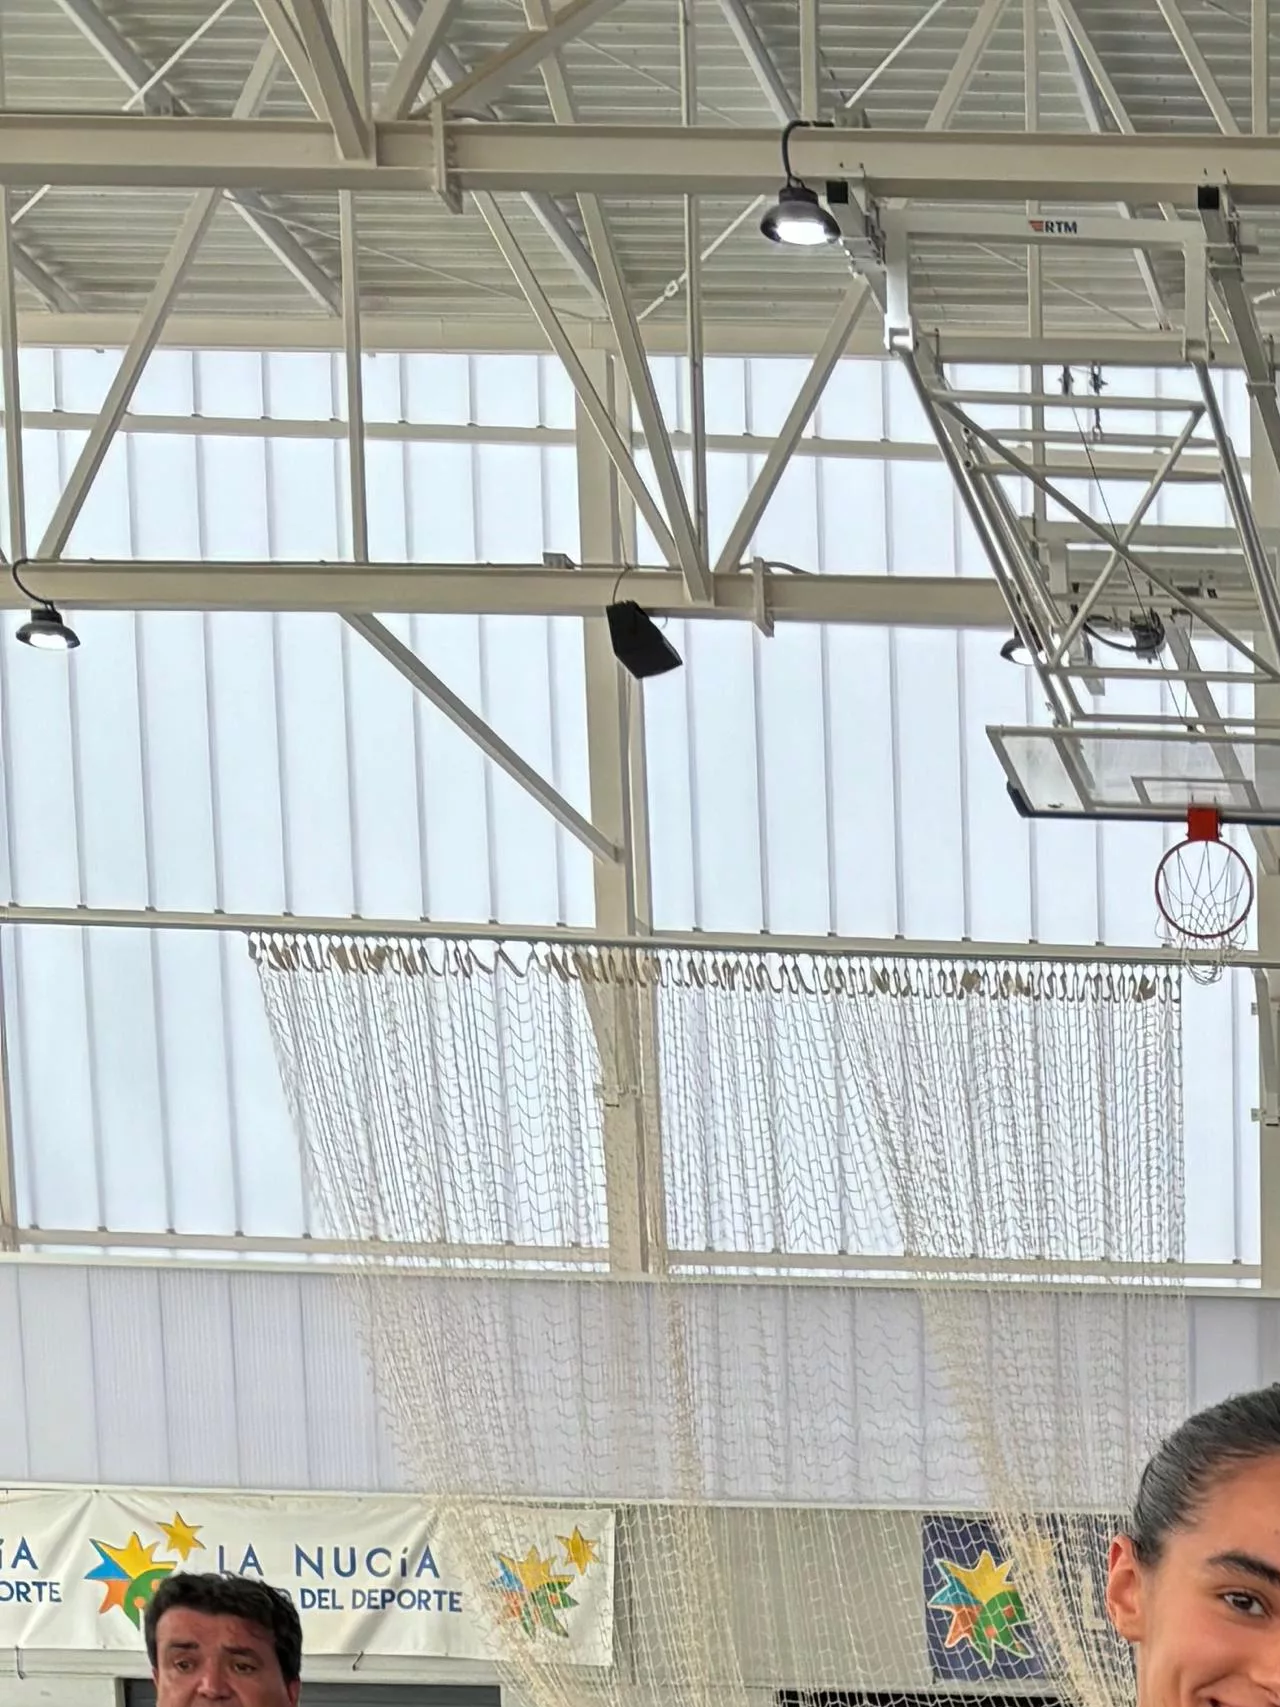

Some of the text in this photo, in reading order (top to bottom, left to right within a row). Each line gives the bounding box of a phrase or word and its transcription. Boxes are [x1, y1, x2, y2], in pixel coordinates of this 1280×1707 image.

[1045, 220, 1078, 234] RTM
[300, 1588, 344, 1610] DEL
[351, 1588, 463, 1613] DEPORTE
